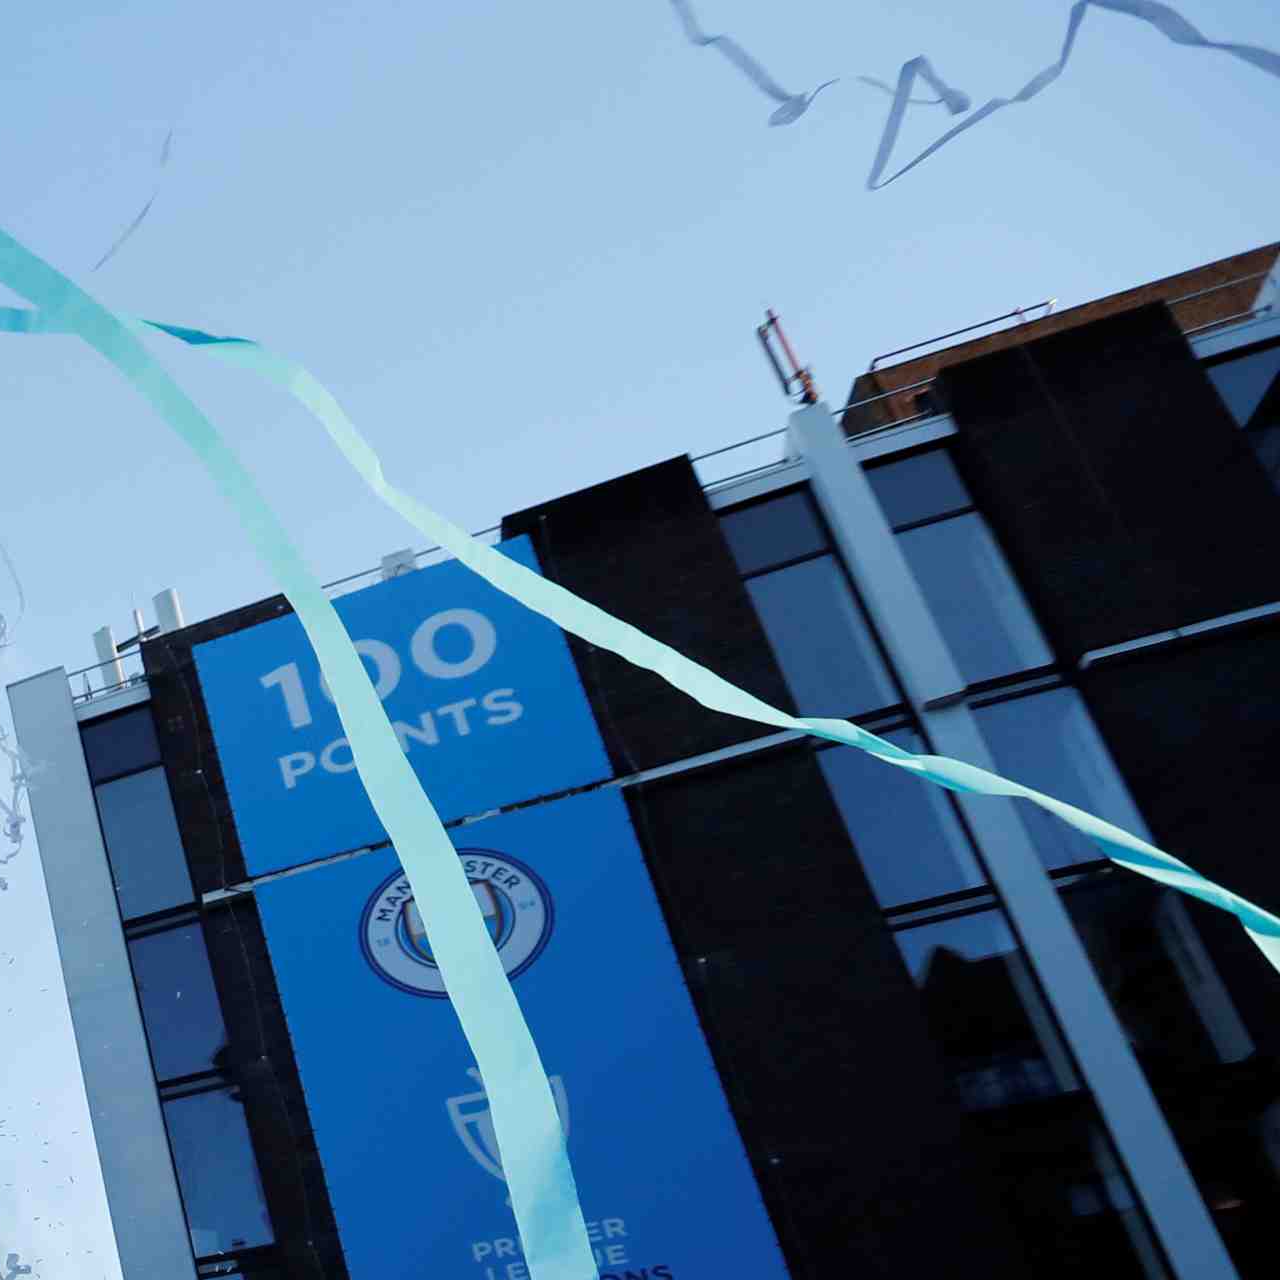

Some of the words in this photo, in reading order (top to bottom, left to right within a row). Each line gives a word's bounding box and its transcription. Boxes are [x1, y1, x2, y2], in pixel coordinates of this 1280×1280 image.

[277, 688, 524, 789] PONTS
[376, 860, 521, 922] MANSTER
[471, 1217, 627, 1263] PRER
